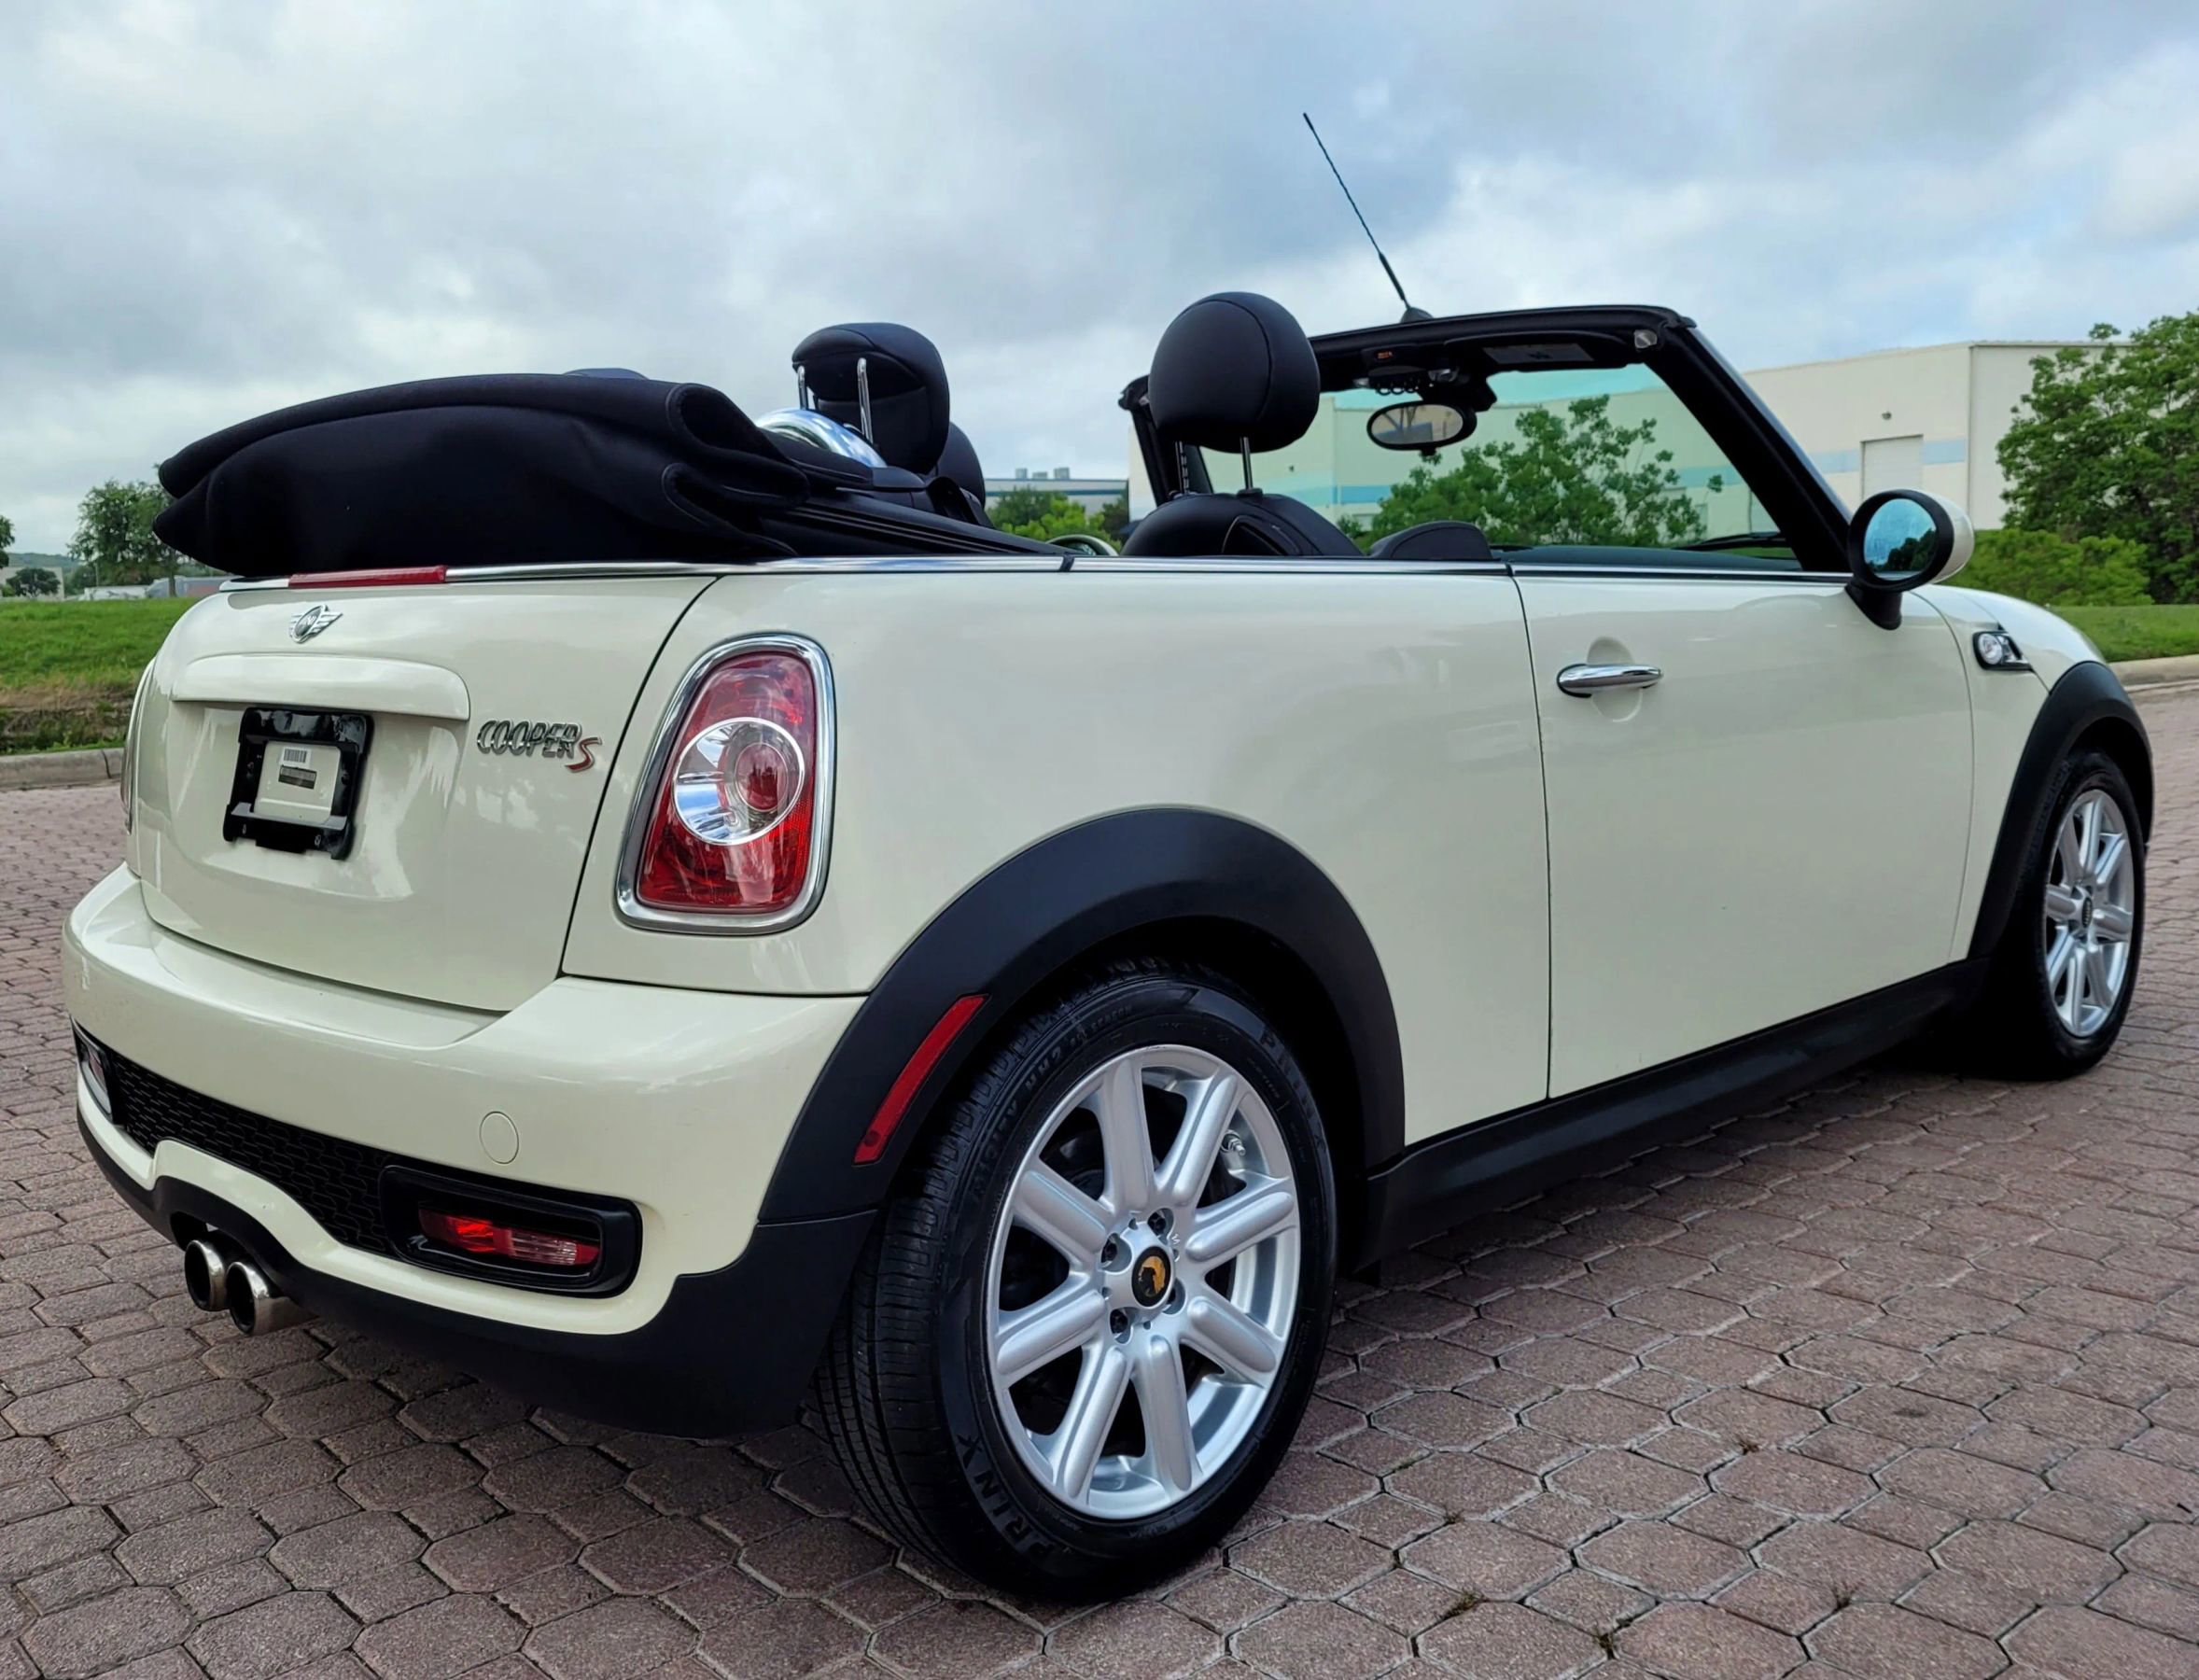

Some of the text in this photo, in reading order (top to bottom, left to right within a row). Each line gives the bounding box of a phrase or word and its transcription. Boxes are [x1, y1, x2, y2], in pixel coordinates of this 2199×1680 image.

[476, 720, 603, 774] COOPER S
[957, 1434, 1055, 1559] PRINX
